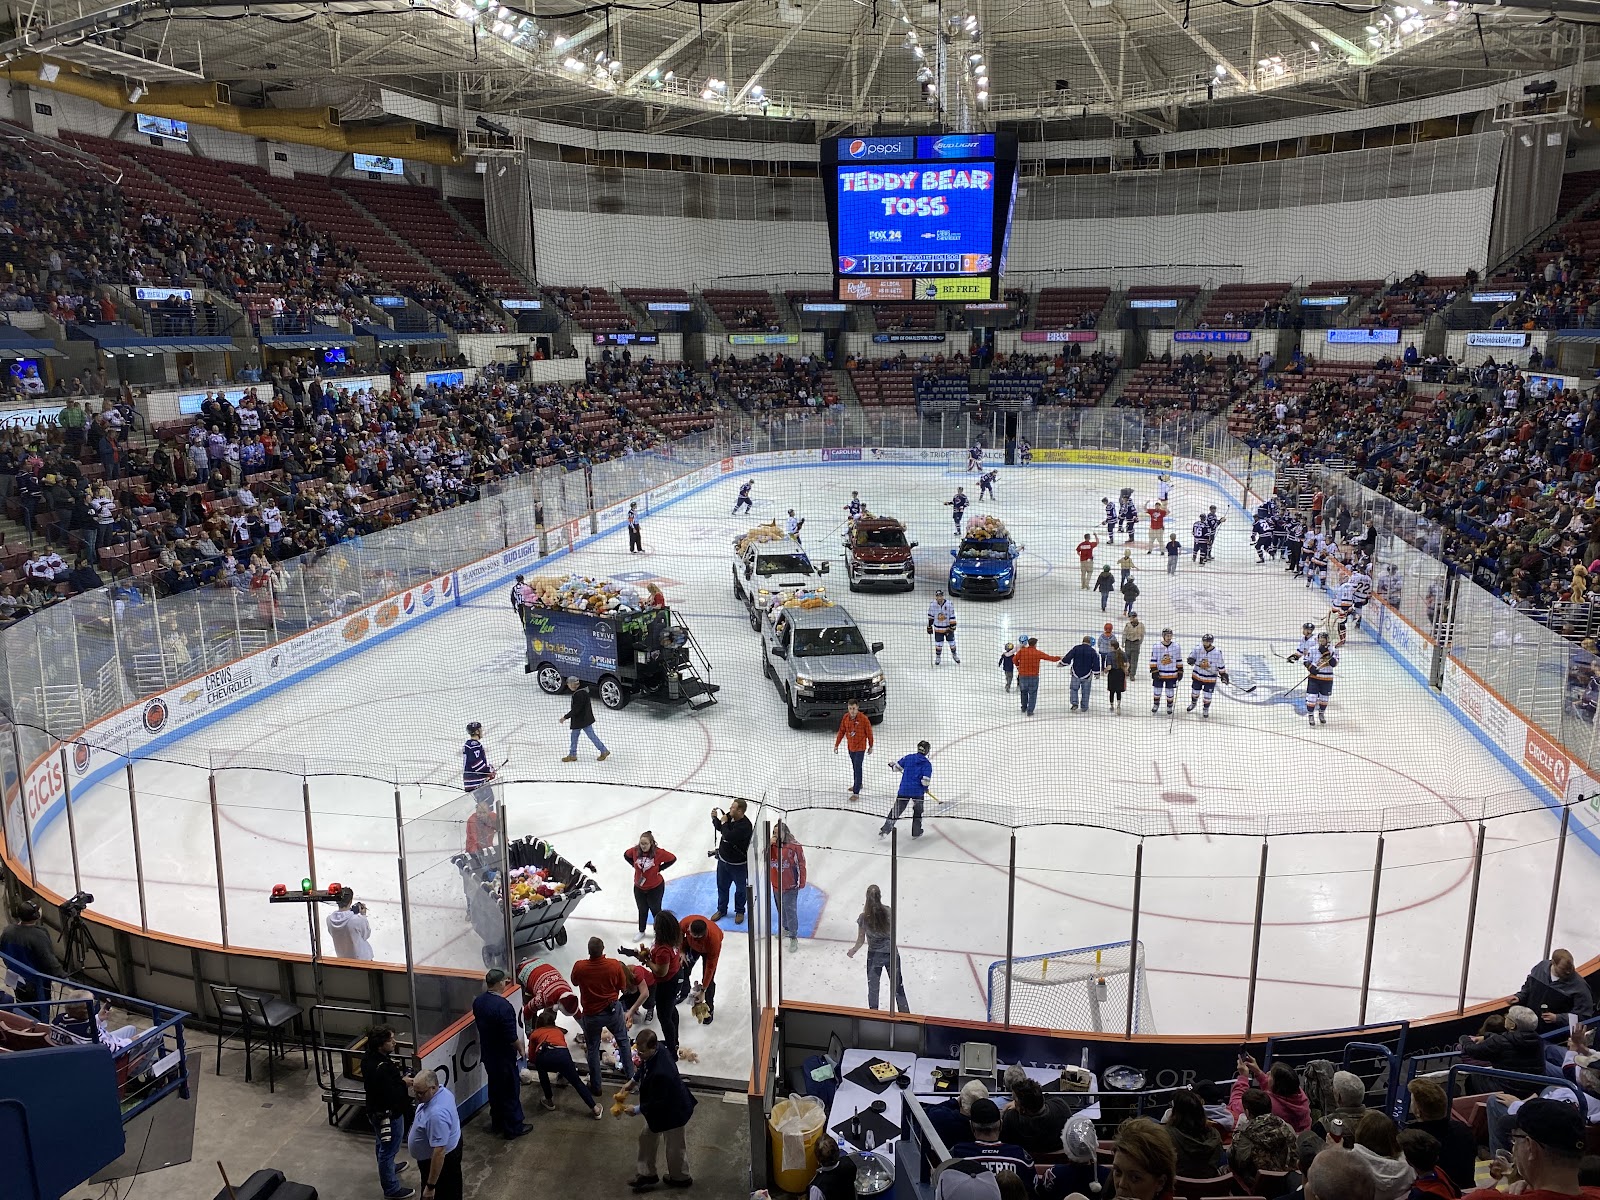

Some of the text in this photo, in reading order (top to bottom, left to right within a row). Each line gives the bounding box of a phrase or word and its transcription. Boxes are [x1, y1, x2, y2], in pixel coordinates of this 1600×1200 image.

[868, 142, 902, 155] pepsi
[954, 141, 979, 149] LIGHT
[840, 169, 991, 192] TEDDY BEAR
[881, 196, 948, 216] TOSS
[869, 230, 902, 240] FOX 24
[862, 259, 867, 269] 1
[874, 263, 880, 271] 2
[887, 263, 892, 271] 1
[901, 262, 928, 272] 17:47
[964, 258, 970, 267] 0
[943, 285, 980, 293] BE FREE
[1175, 332, 1213, 340] GERALD'S
[503, 542, 535, 565] BUD LIGHT
[1356, 582, 1371, 594] 22
[592, 630, 615, 640] REVIVE
[545, 641, 578, 655] liquidbox
[555, 653, 581, 663] TRUCKING
[206, 667, 232, 691] CREWS
[207, 676, 254, 704] CHEVROLET
[1528, 741, 1554, 772] CIRCLE
[28, 760, 63, 819] cicis
